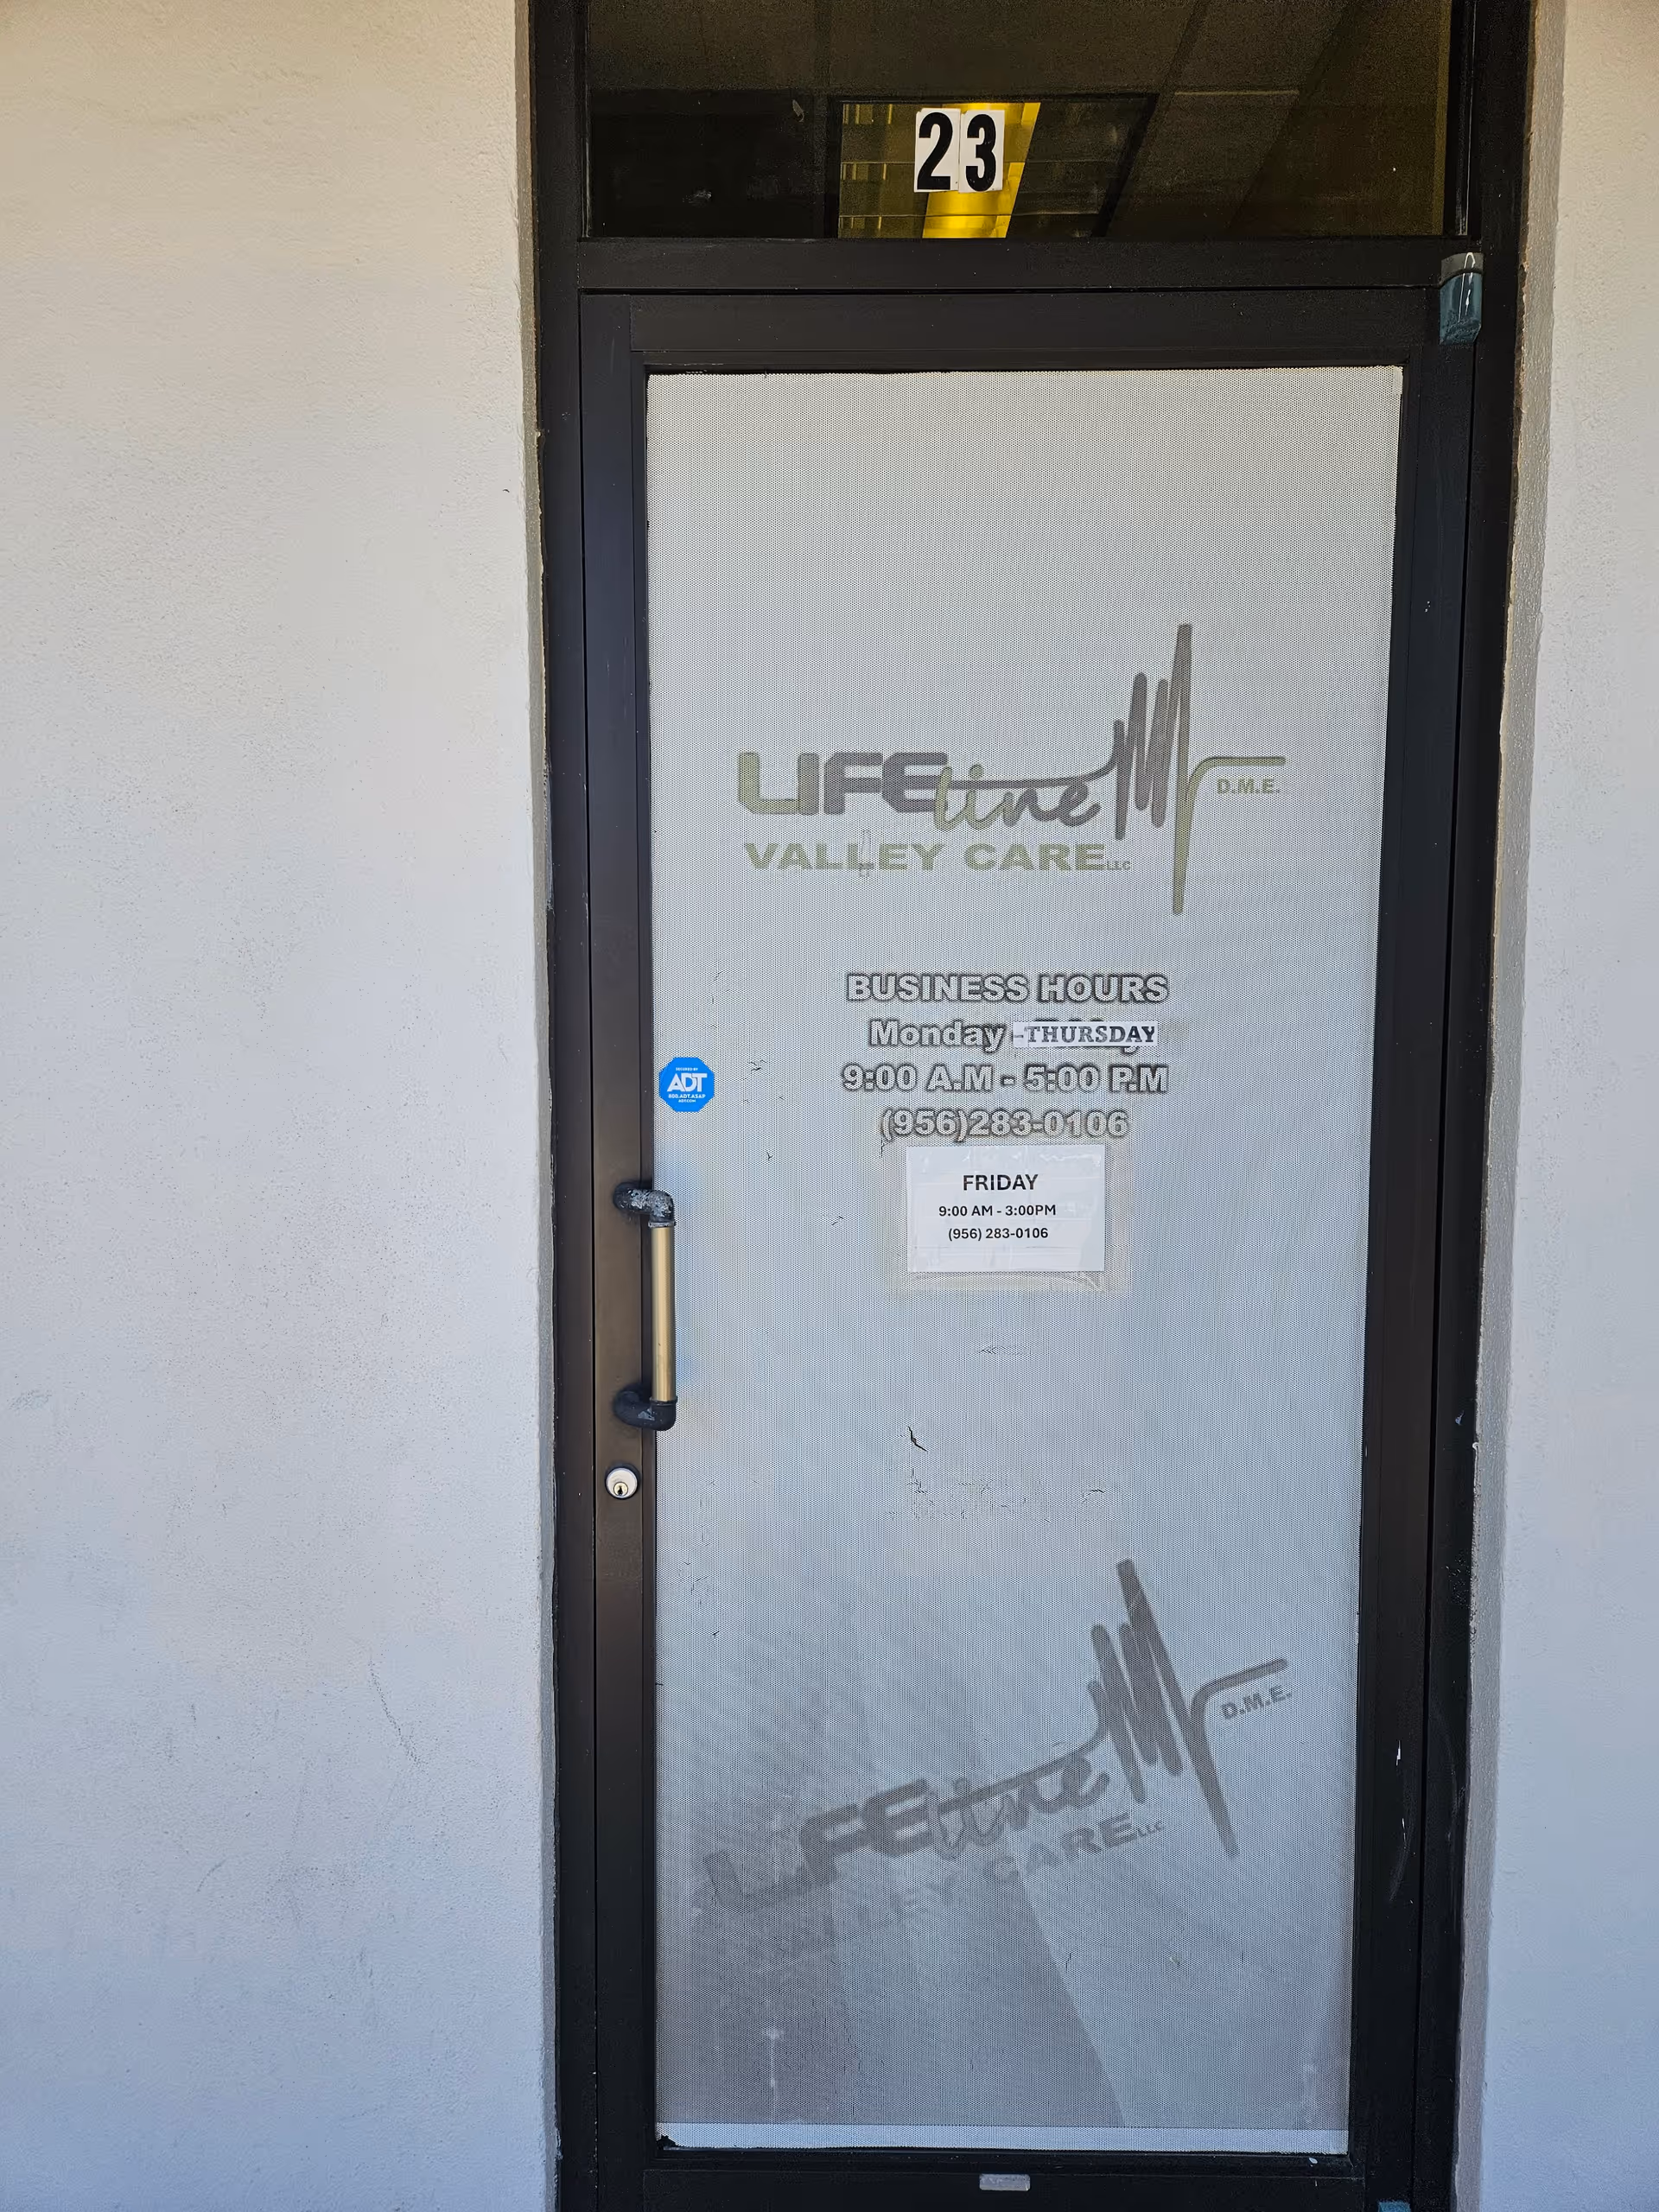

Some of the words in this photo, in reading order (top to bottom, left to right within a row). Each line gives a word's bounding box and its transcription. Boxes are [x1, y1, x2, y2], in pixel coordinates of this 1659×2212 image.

[917, 111, 996, 192] 23
[1216, 779, 1281, 795] D.M.E.
[744, 842, 946, 871] VALLEY
[963, 842, 1105, 871] CARE
[1106, 860, 1131, 870] LLC
[846, 973, 1030, 1004] BUSINESS
[1038, 973, 1170, 1003] HOURS
[868, 1018, 1007, 1053] Monday
[667, 1072, 708, 1092] ADT
[841, 1063, 918, 1092] 9:00
[1022, 1063, 1100, 1092] 5:00
[1109, 1063, 1170, 1092] P.M
[880, 1109, 1129, 1142] (956)283-0106
[963, 1173, 1039, 1191] FRIDAY
[938, 1205, 968, 1216] 9:00
[971, 1205, 993, 1216] AM
[1005, 1205, 1056, 1216] 3:00PM
[948, 1227, 982, 1241] (956)
[986, 1227, 1048, 1239] 283-0106
[1221, 1684, 1293, 1720] D.M.E.
[983, 1812, 1138, 1887] CARE
